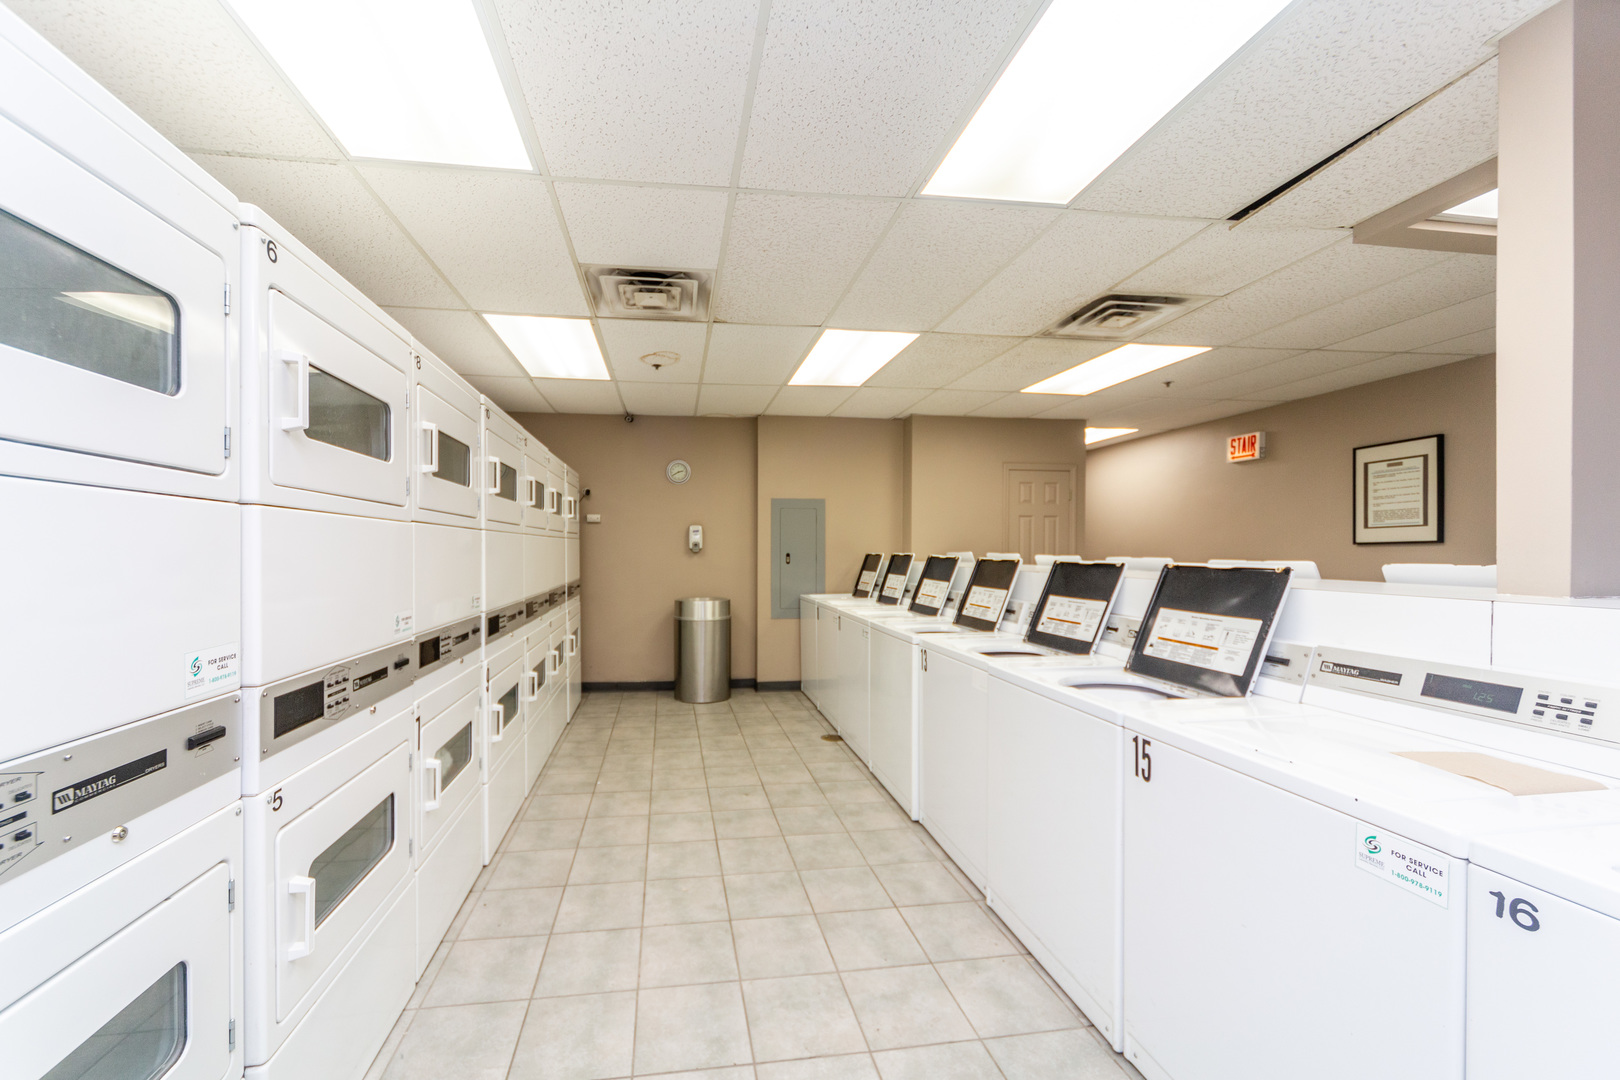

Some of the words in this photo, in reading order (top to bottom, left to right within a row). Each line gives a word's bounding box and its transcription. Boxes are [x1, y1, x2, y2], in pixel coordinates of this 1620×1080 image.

[267, 240, 277, 263] 6
[416, 355, 421, 369] 8
[1231, 435, 1257, 455] STAIR
[218, 653, 236, 663] SERVICE
[920, 648, 928, 672] 13
[1333, 665, 1359, 676] MAYTAG
[1132, 735, 1151, 782] 15
[75, 775, 116, 799] MAYTAG
[272, 788, 283, 812] 5
[1359, 851, 1385, 867] SUPREME
[1391, 849, 1406, 861] FOR
[1408, 857, 1444, 877] SERVICE
[1405, 864, 1427, 878] CALL
[1391, 869, 1443, 897] 1-800-978-9119
[1489, 891, 1540, 932] 16
